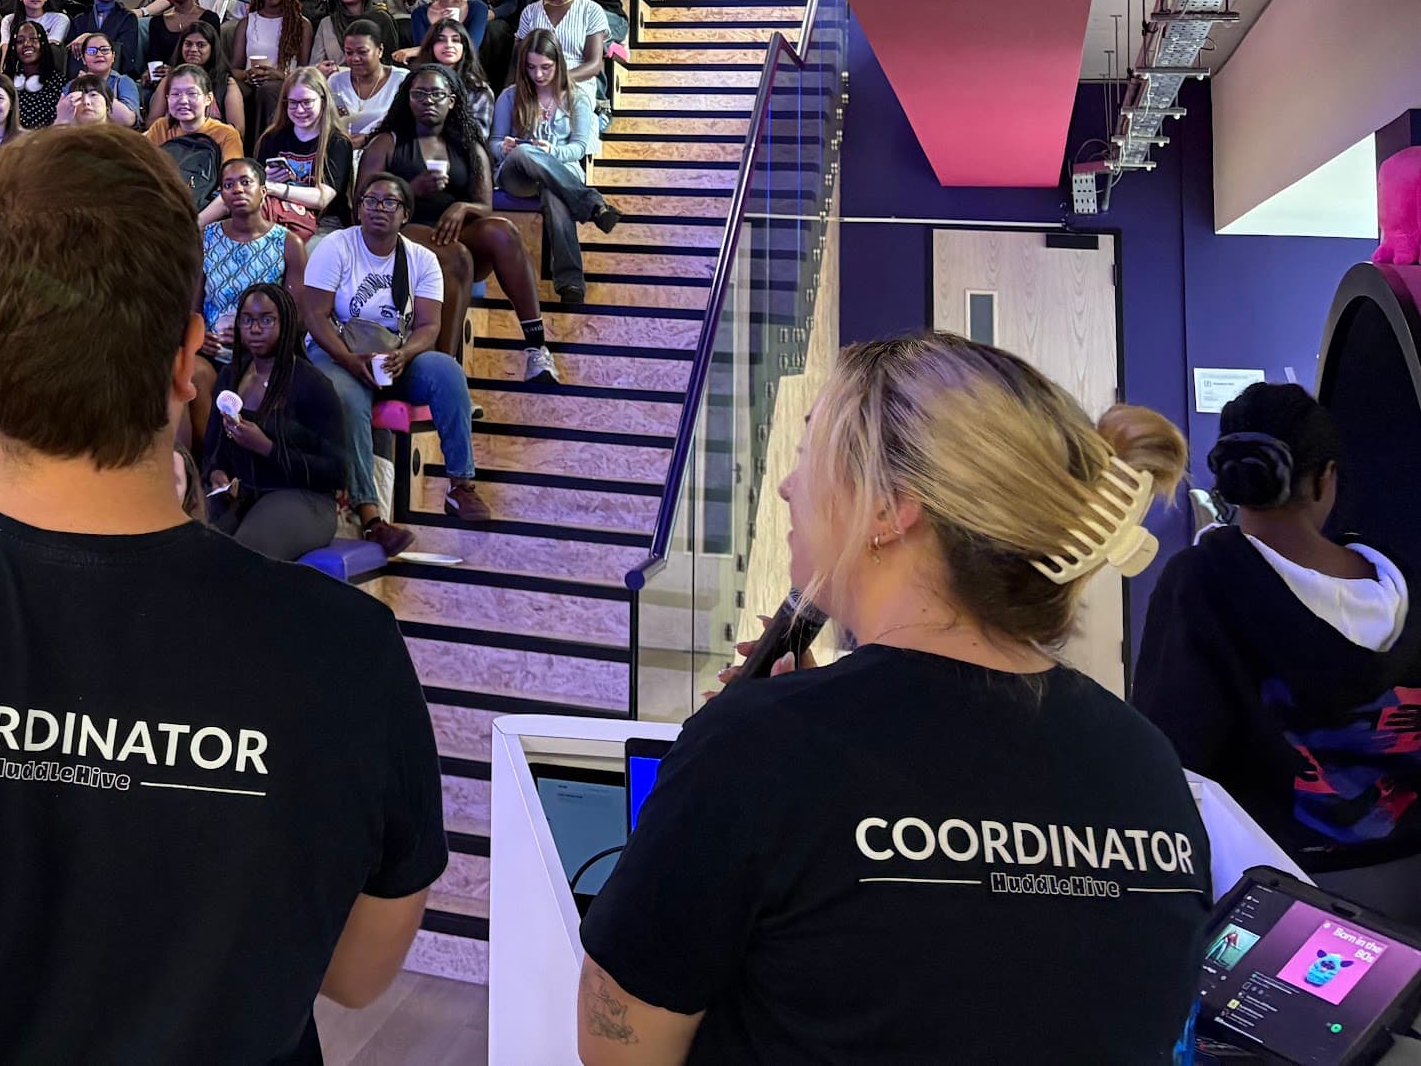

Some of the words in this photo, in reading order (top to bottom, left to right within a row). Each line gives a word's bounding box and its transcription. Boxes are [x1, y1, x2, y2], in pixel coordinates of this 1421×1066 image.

[855, 817, 1195, 875] COORDINATOR
[990, 872, 1120, 899] HuddleHive
[1333, 927, 1357, 943] Born
